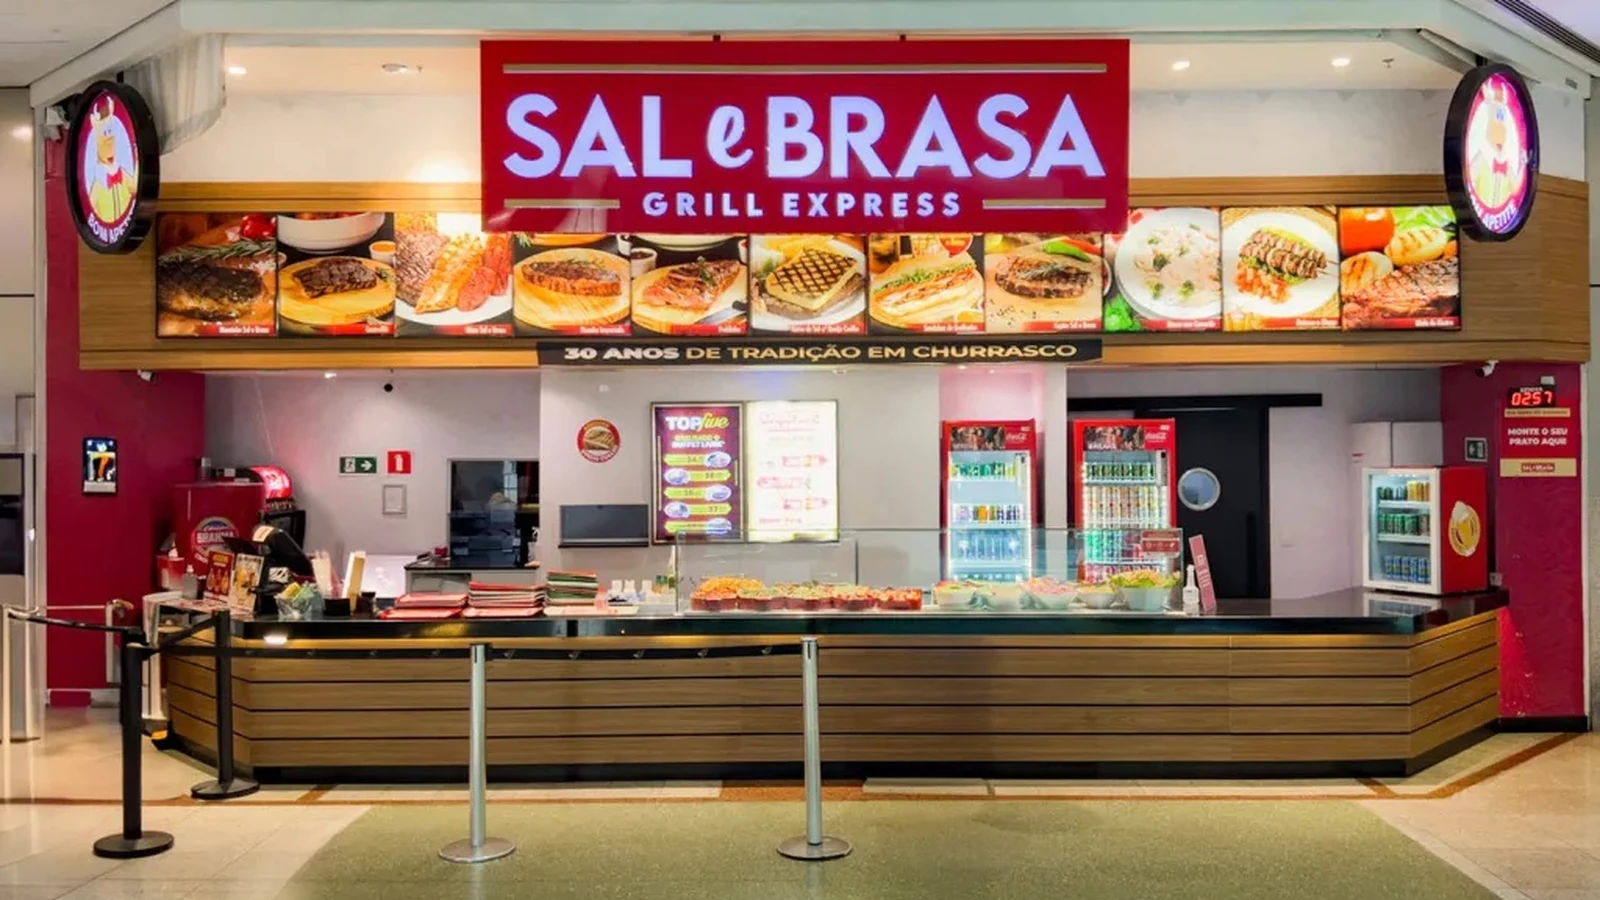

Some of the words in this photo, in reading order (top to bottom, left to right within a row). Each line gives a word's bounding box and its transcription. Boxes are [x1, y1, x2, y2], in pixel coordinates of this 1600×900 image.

[503, 93, 693, 178] SAL
[706, 105, 754, 169] e
[767, 93, 1106, 179] BRASA
[642, 193, 764, 217] GRILL
[782, 193, 961, 218] EXPRESS
[564, 347, 597, 360] 30
[603, 347, 680, 360] ANOS
[685, 347, 721, 360] DE
[727, 344, 861, 364] TRADIÇÃO
[868, 346, 905, 359] EM
[913, 344, 1077, 359] CHURRASCO
[1511, 391, 1553, 406] 0257
[664, 416, 701, 431] TOP
[699, 412, 730, 431] five
[1507, 427, 1540, 435] MONTE
[1541, 427, 1549, 435] O
[1550, 427, 1568, 435] SEU
[1509, 437, 1540, 445] PRATO
